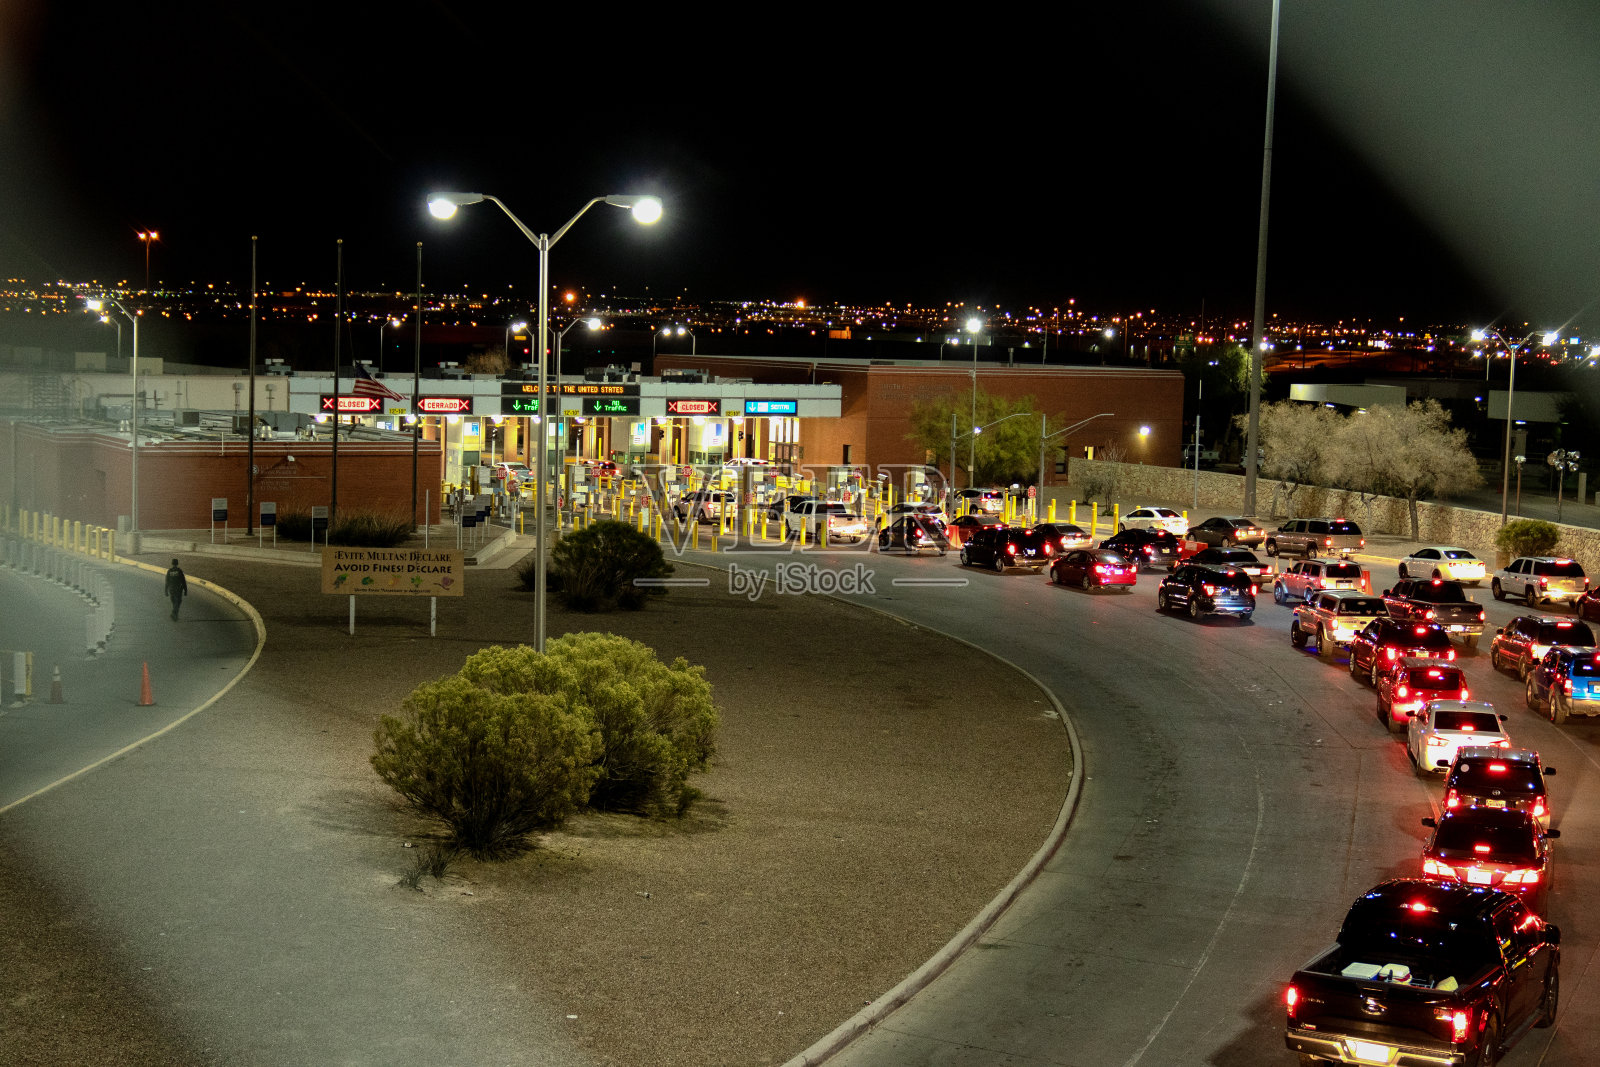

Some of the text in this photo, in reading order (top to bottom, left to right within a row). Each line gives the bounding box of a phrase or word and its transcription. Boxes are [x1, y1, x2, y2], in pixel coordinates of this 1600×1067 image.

[522, 385, 550, 393] WELCE
[334, 550, 452, 562] ¡EVITE MULTAS! DECLARE
[334, 563, 452, 574] AVOID FINES! DECLARE
